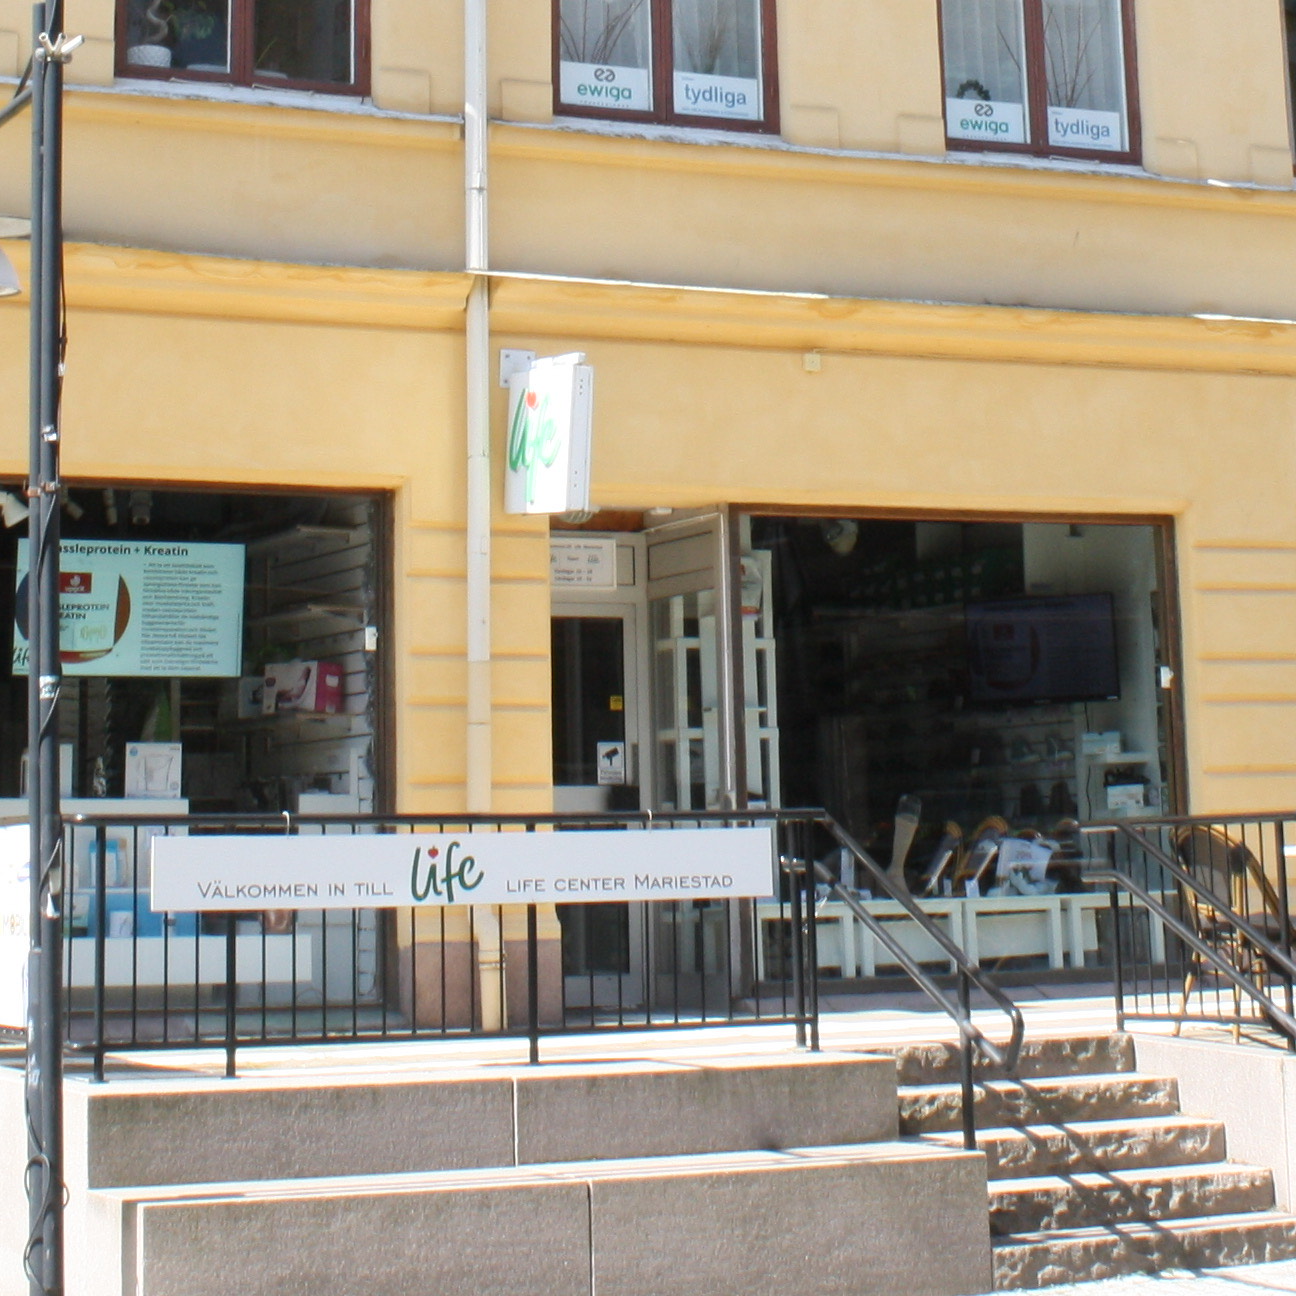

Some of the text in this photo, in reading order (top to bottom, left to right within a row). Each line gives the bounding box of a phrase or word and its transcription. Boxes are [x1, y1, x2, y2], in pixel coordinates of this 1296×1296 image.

[577, 83, 632, 102] ewiga
[685, 84, 747, 108] tydliga
[960, 118, 1009, 135] ewiga
[1054, 118, 1110, 140] tydliga
[59, 544, 131, 556] ssleprotein
[144, 545, 189, 556] Kreatin
[197, 879, 319, 899] VÄLKOMMEN
[327, 883, 346, 898] IN
[354, 882, 394, 897] TILL
